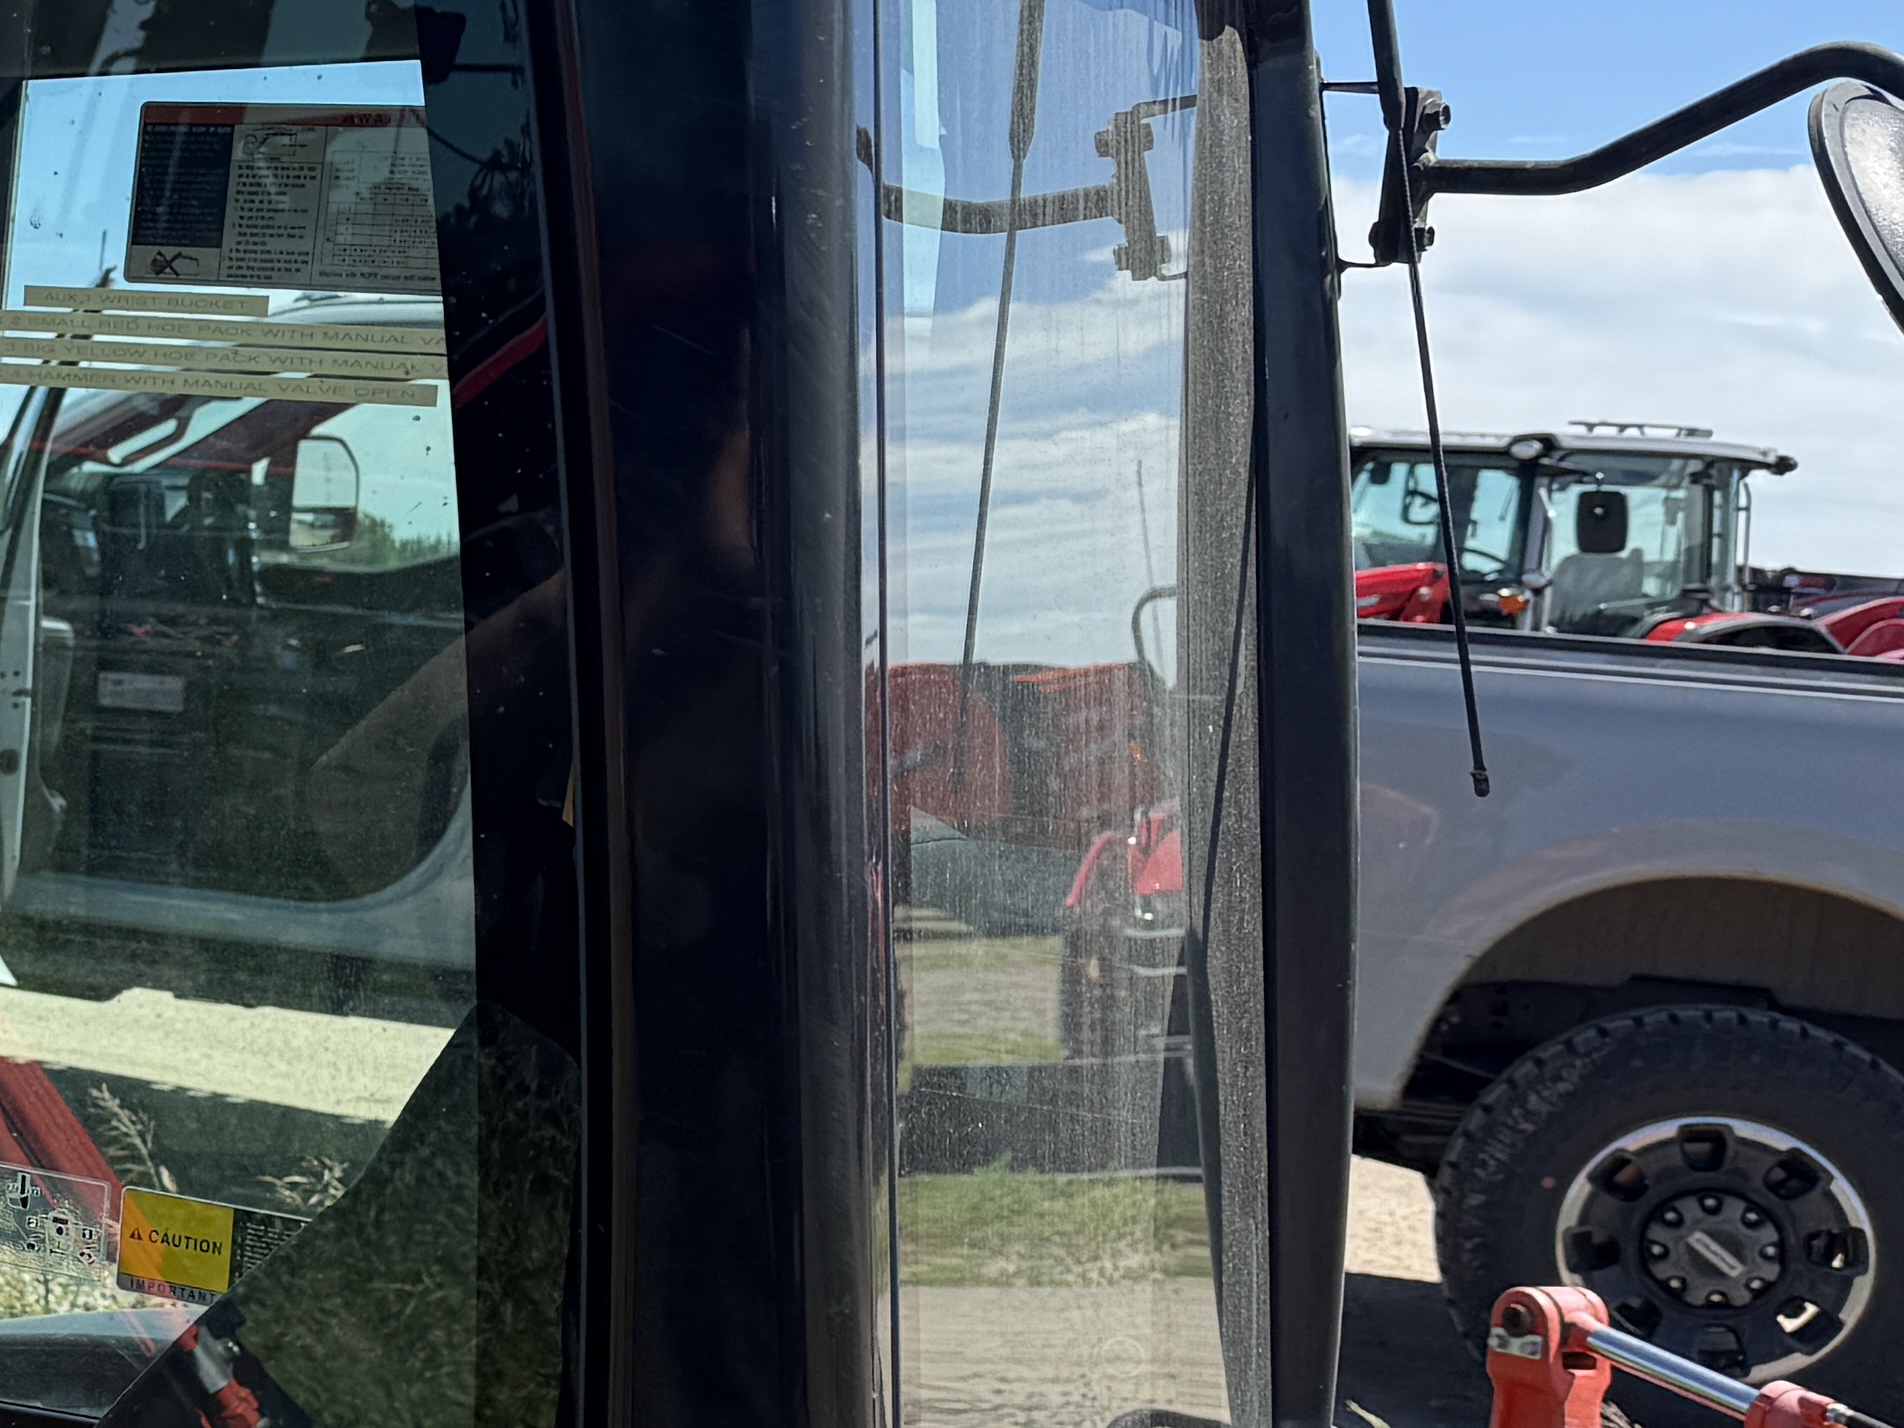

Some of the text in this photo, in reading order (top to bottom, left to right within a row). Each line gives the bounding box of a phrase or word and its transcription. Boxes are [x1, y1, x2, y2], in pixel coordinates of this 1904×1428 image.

[44, 292, 80, 303] AUX
[100, 294, 164, 307] WRIST
[170, 297, 248, 311] BUCKET
[26, 317, 90, 329] SMALL
[97, 320, 140, 331] RED
[147, 322, 192, 334] HOE
[198, 324, 252, 337] PACK
[261, 327, 314, 341] WITH
[321, 330, 413, 345] MANUAL
[4, 343, 16, 352] 3
[23, 343, 57, 354] BIG
[63, 345, 147, 359] YELLOW
[154, 348, 198, 361] HOE
[205, 351, 261, 364] PACK
[269, 354, 323, 368] WITH
[331, 358, 418, 373] MANUAL
[29, 369, 117, 385] HAMMER
[123, 375, 176, 387] WITH
[182, 379, 270, 393] MANUAL
[277, 382, 346, 396] VALVE
[353, 386, 416, 400] OPEN
[148, 1229, 223, 1256] CAUTION
[129, 1278, 216, 1305] IMPORTANT
